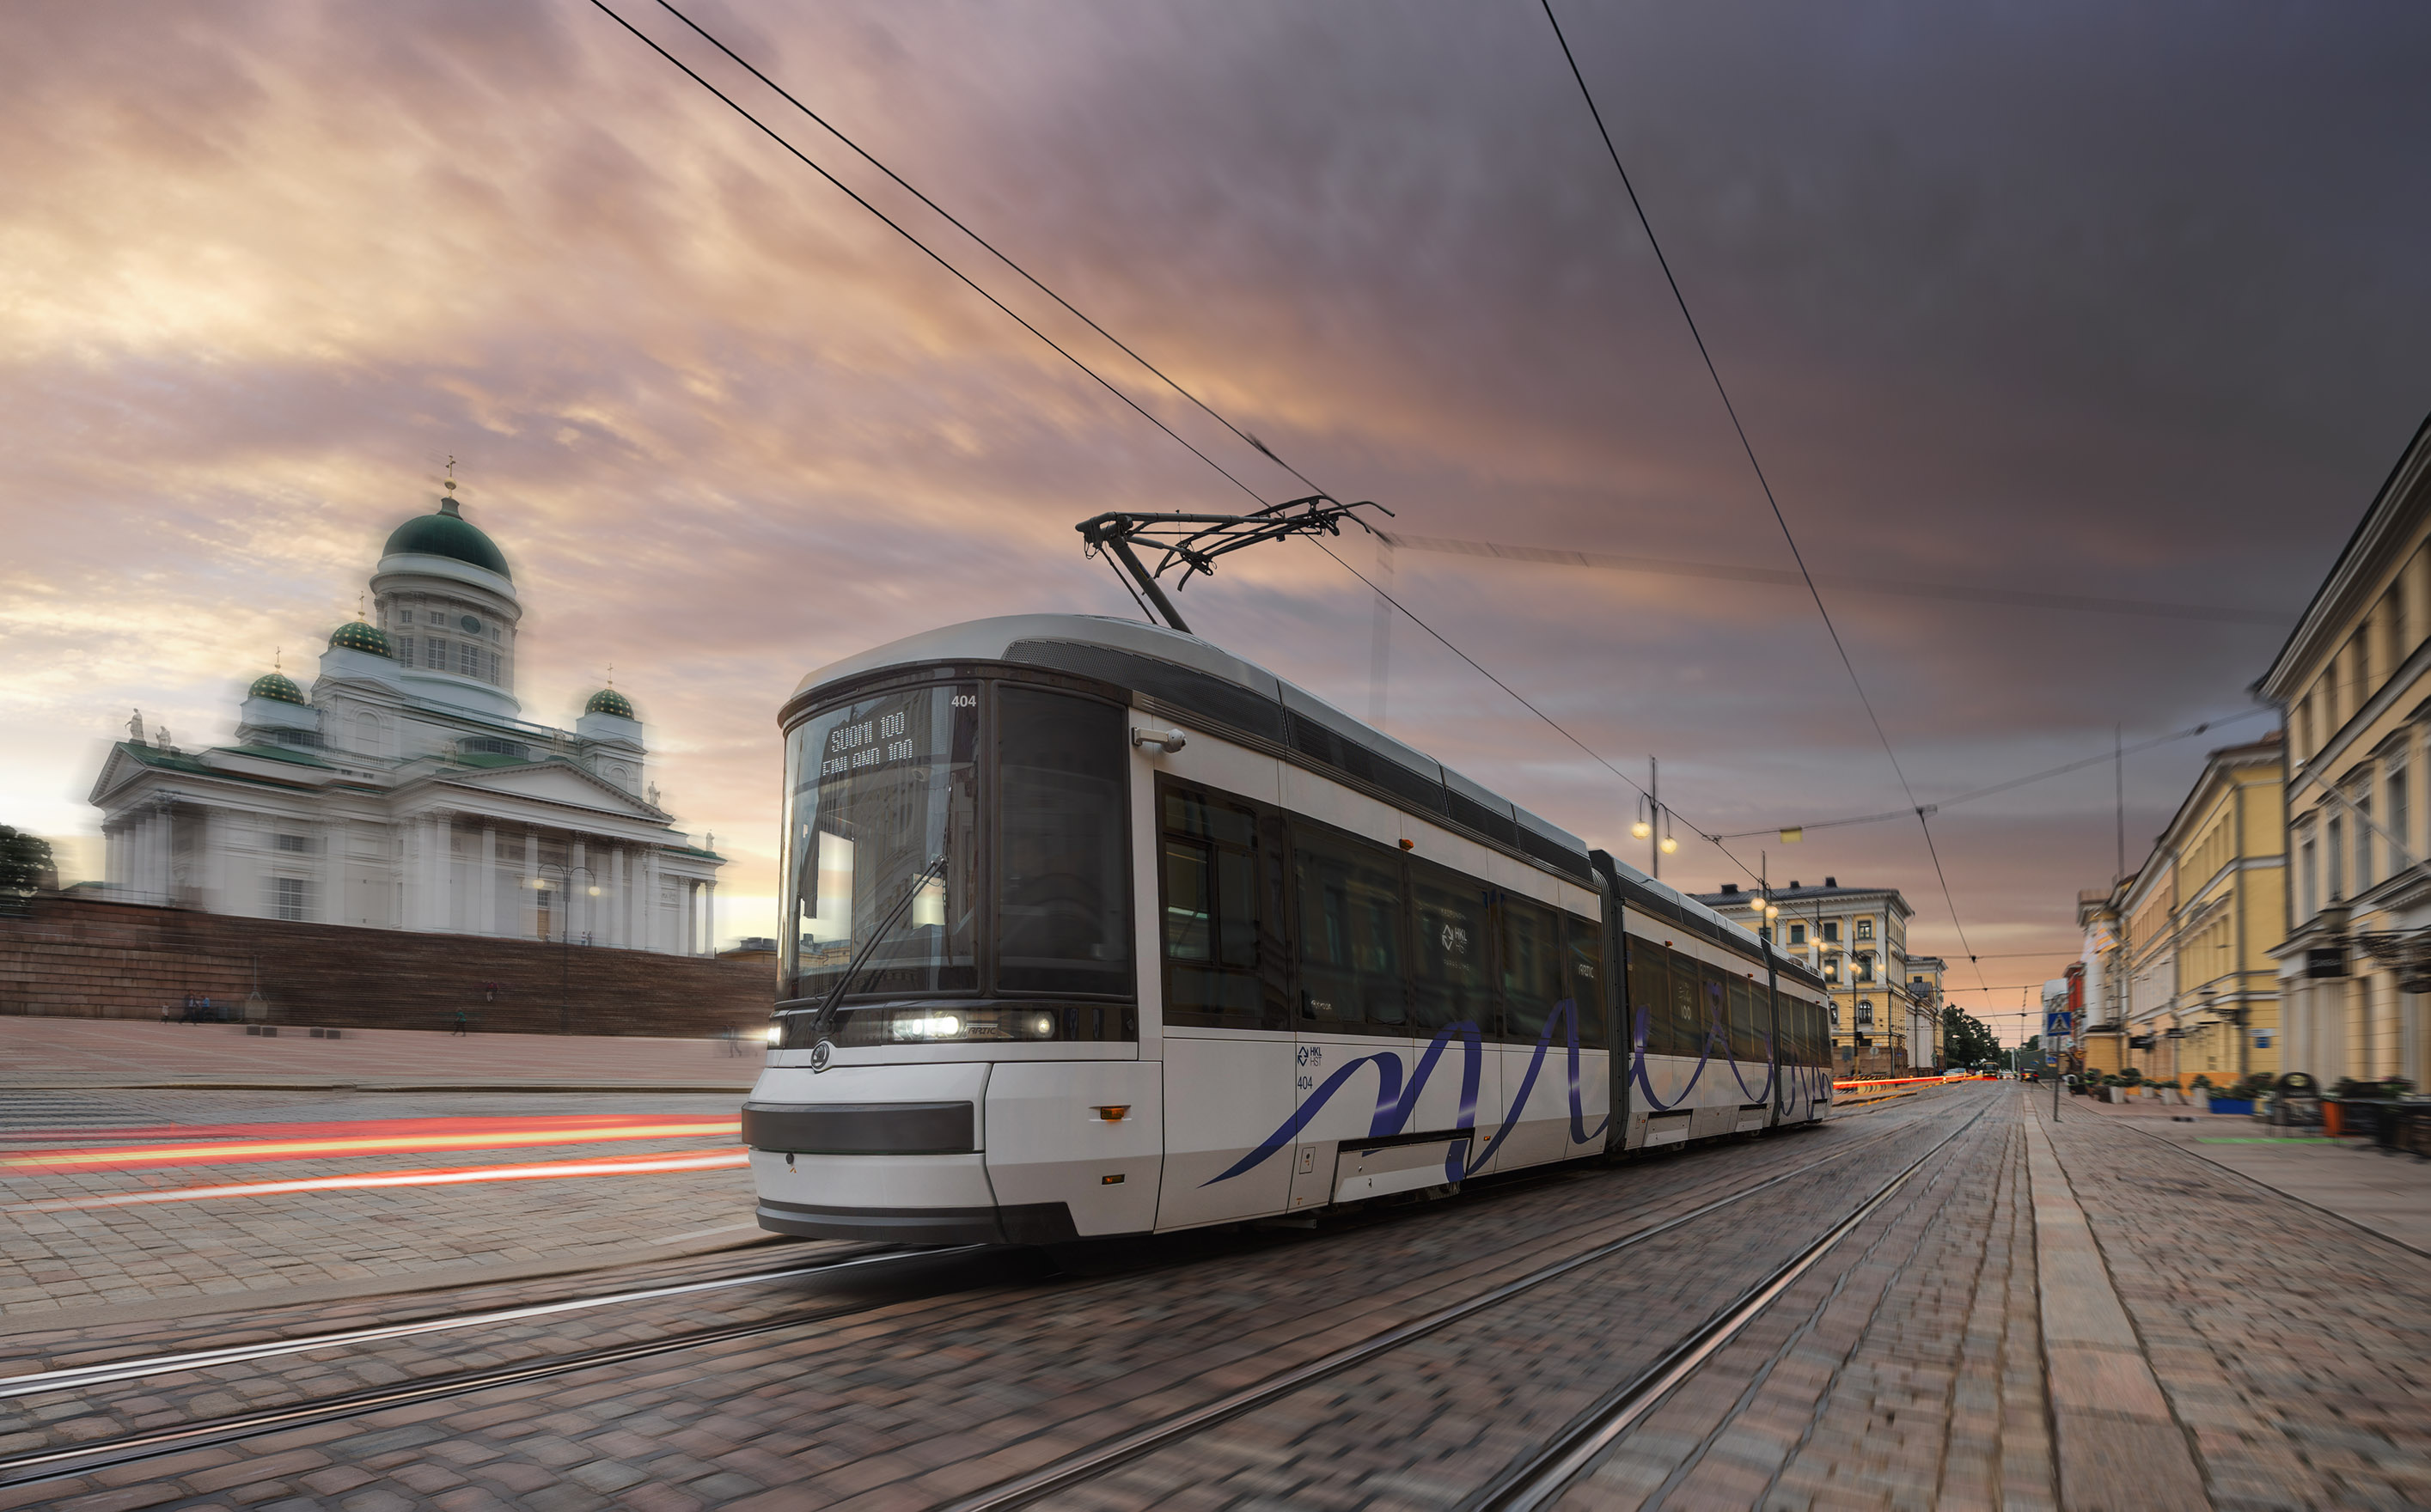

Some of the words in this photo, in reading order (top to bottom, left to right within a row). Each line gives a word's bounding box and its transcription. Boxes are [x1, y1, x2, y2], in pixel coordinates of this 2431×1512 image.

[951, 695, 977, 707] 404
[831, 721, 872, 753] SUOMI
[881, 711, 905, 739] 100
[888, 738, 913, 761] 100
[1454, 927, 1468, 942] HKL
[1681, 1004, 1692, 1021] 100
[1310, 1046, 1322, 1057] HKL
[1310, 1056, 1322, 1066] HST
[1298, 1076, 1313, 1090] 404
